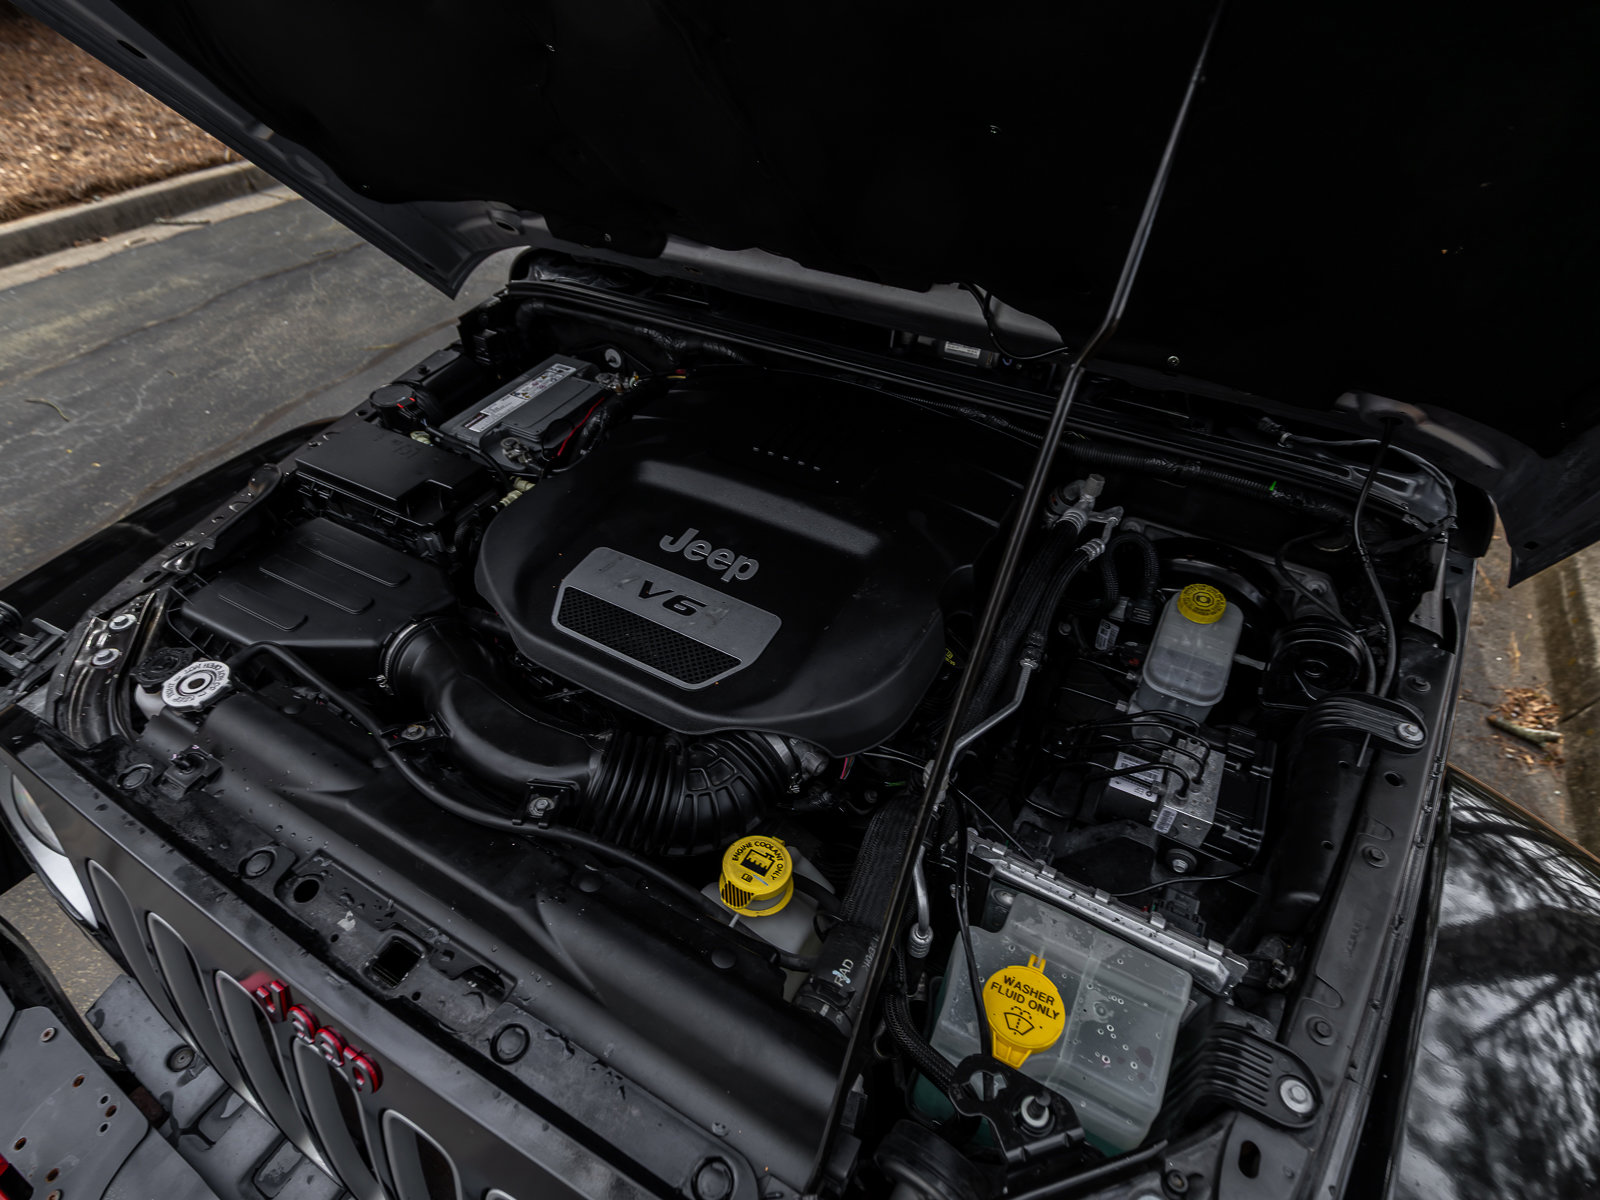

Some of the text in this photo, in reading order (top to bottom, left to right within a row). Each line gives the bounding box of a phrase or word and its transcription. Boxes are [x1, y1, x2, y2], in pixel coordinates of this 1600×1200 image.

[659, 527, 760, 583] Jeep
[638, 580, 708, 617] V6
[732, 841, 784, 881] ENGINE COOLANT ONLY
[990, 981, 1060, 1020] FLUID ONLY
[1003, 975, 1055, 1006] WASHER
